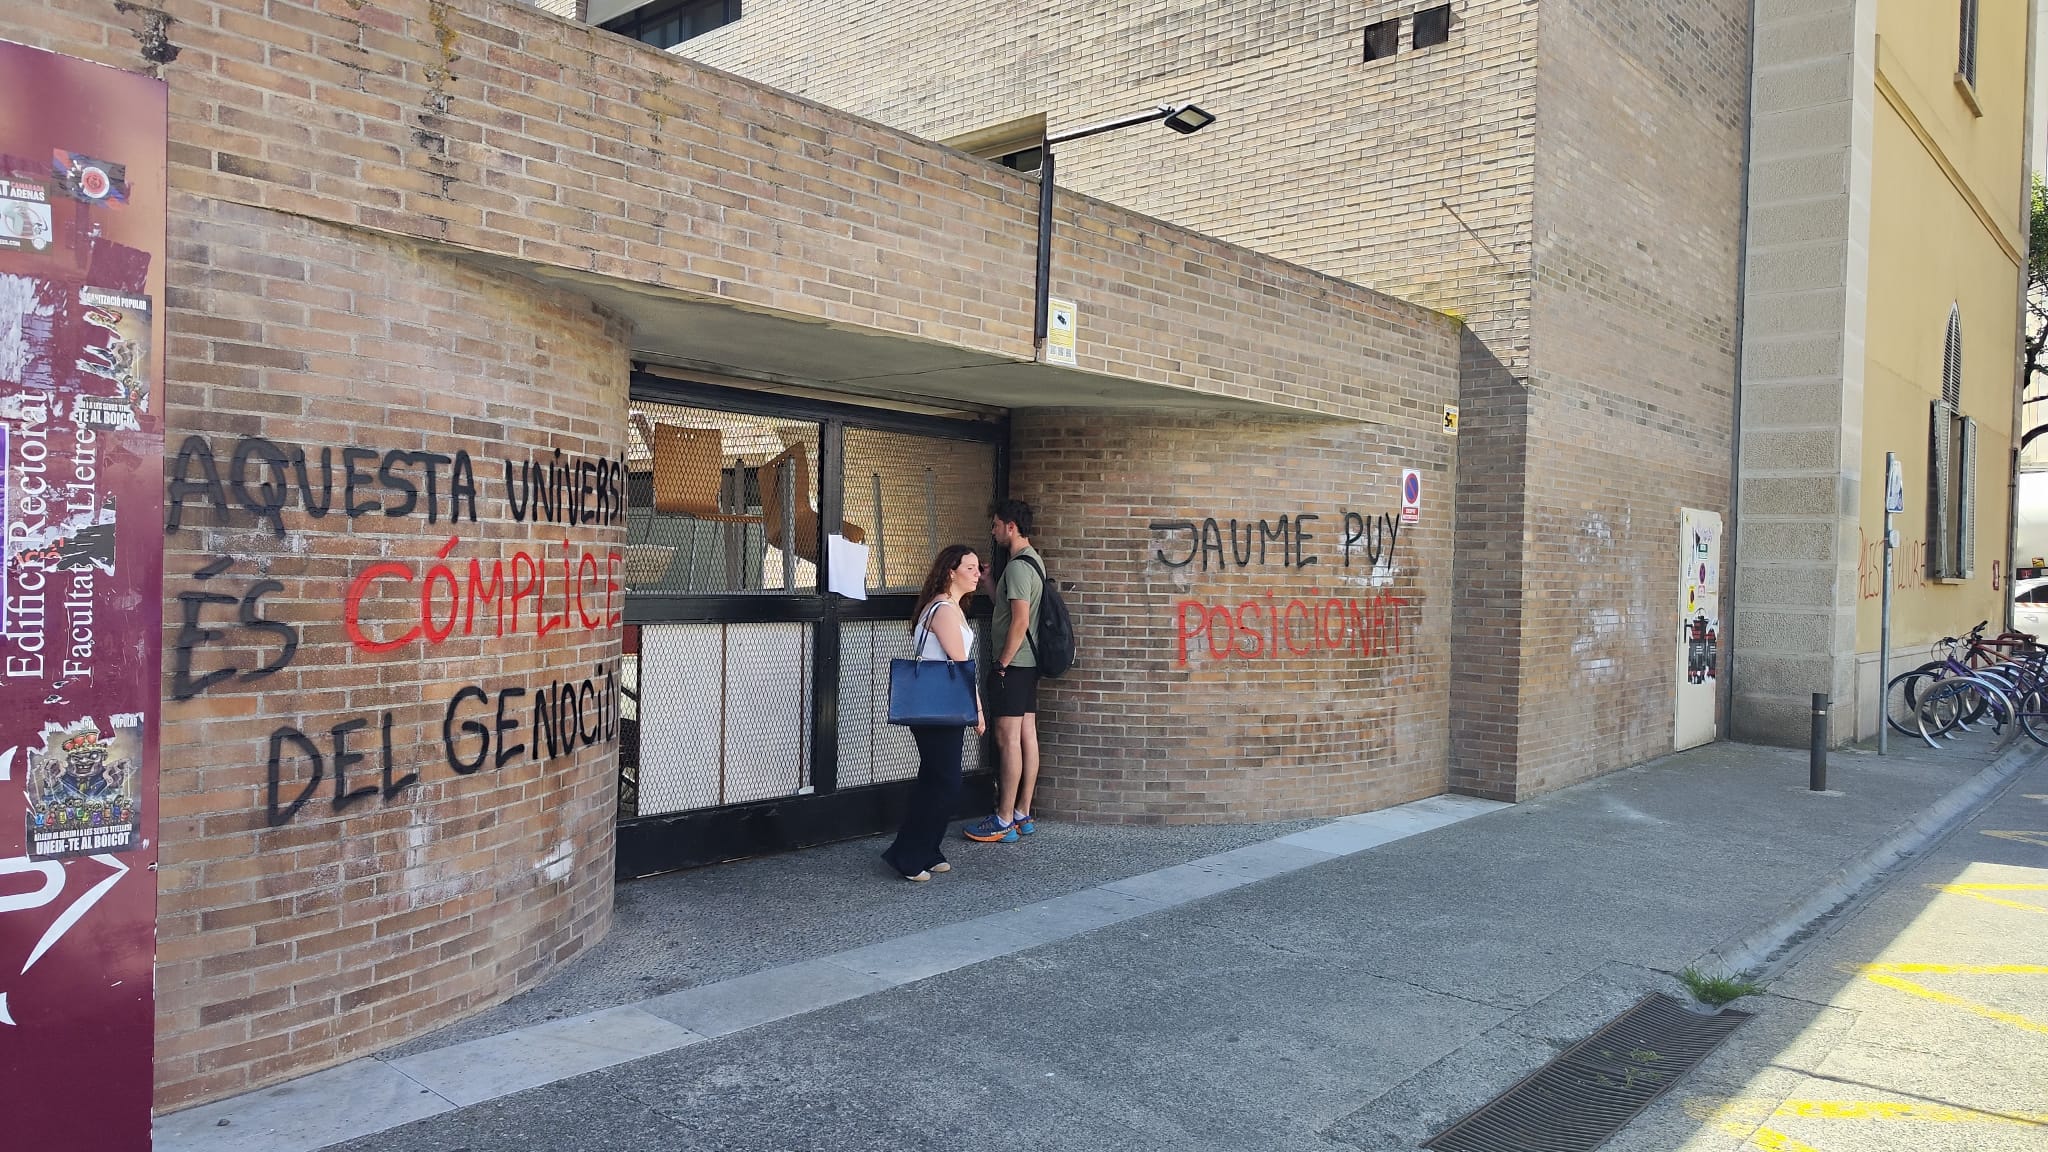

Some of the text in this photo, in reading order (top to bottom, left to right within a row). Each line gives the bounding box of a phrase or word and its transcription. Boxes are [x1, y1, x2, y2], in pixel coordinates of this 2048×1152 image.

[10, 187, 45, 201] ARENAS
[8, 389, 48, 545] Rectorat
[103, 410, 135, 426] BOICO
[166, 435, 477, 537] AQUESTA
[63, 427, 97, 678] Facultat Lletre
[1149, 511, 1400, 572] JAUME PUY
[6, 560, 45, 679] Edifici
[172, 555, 299, 703] ÉS
[267, 663, 619, 828] DEL GENOCID
[36, 832, 131, 855] UNEIX-TE AL BOICOT
